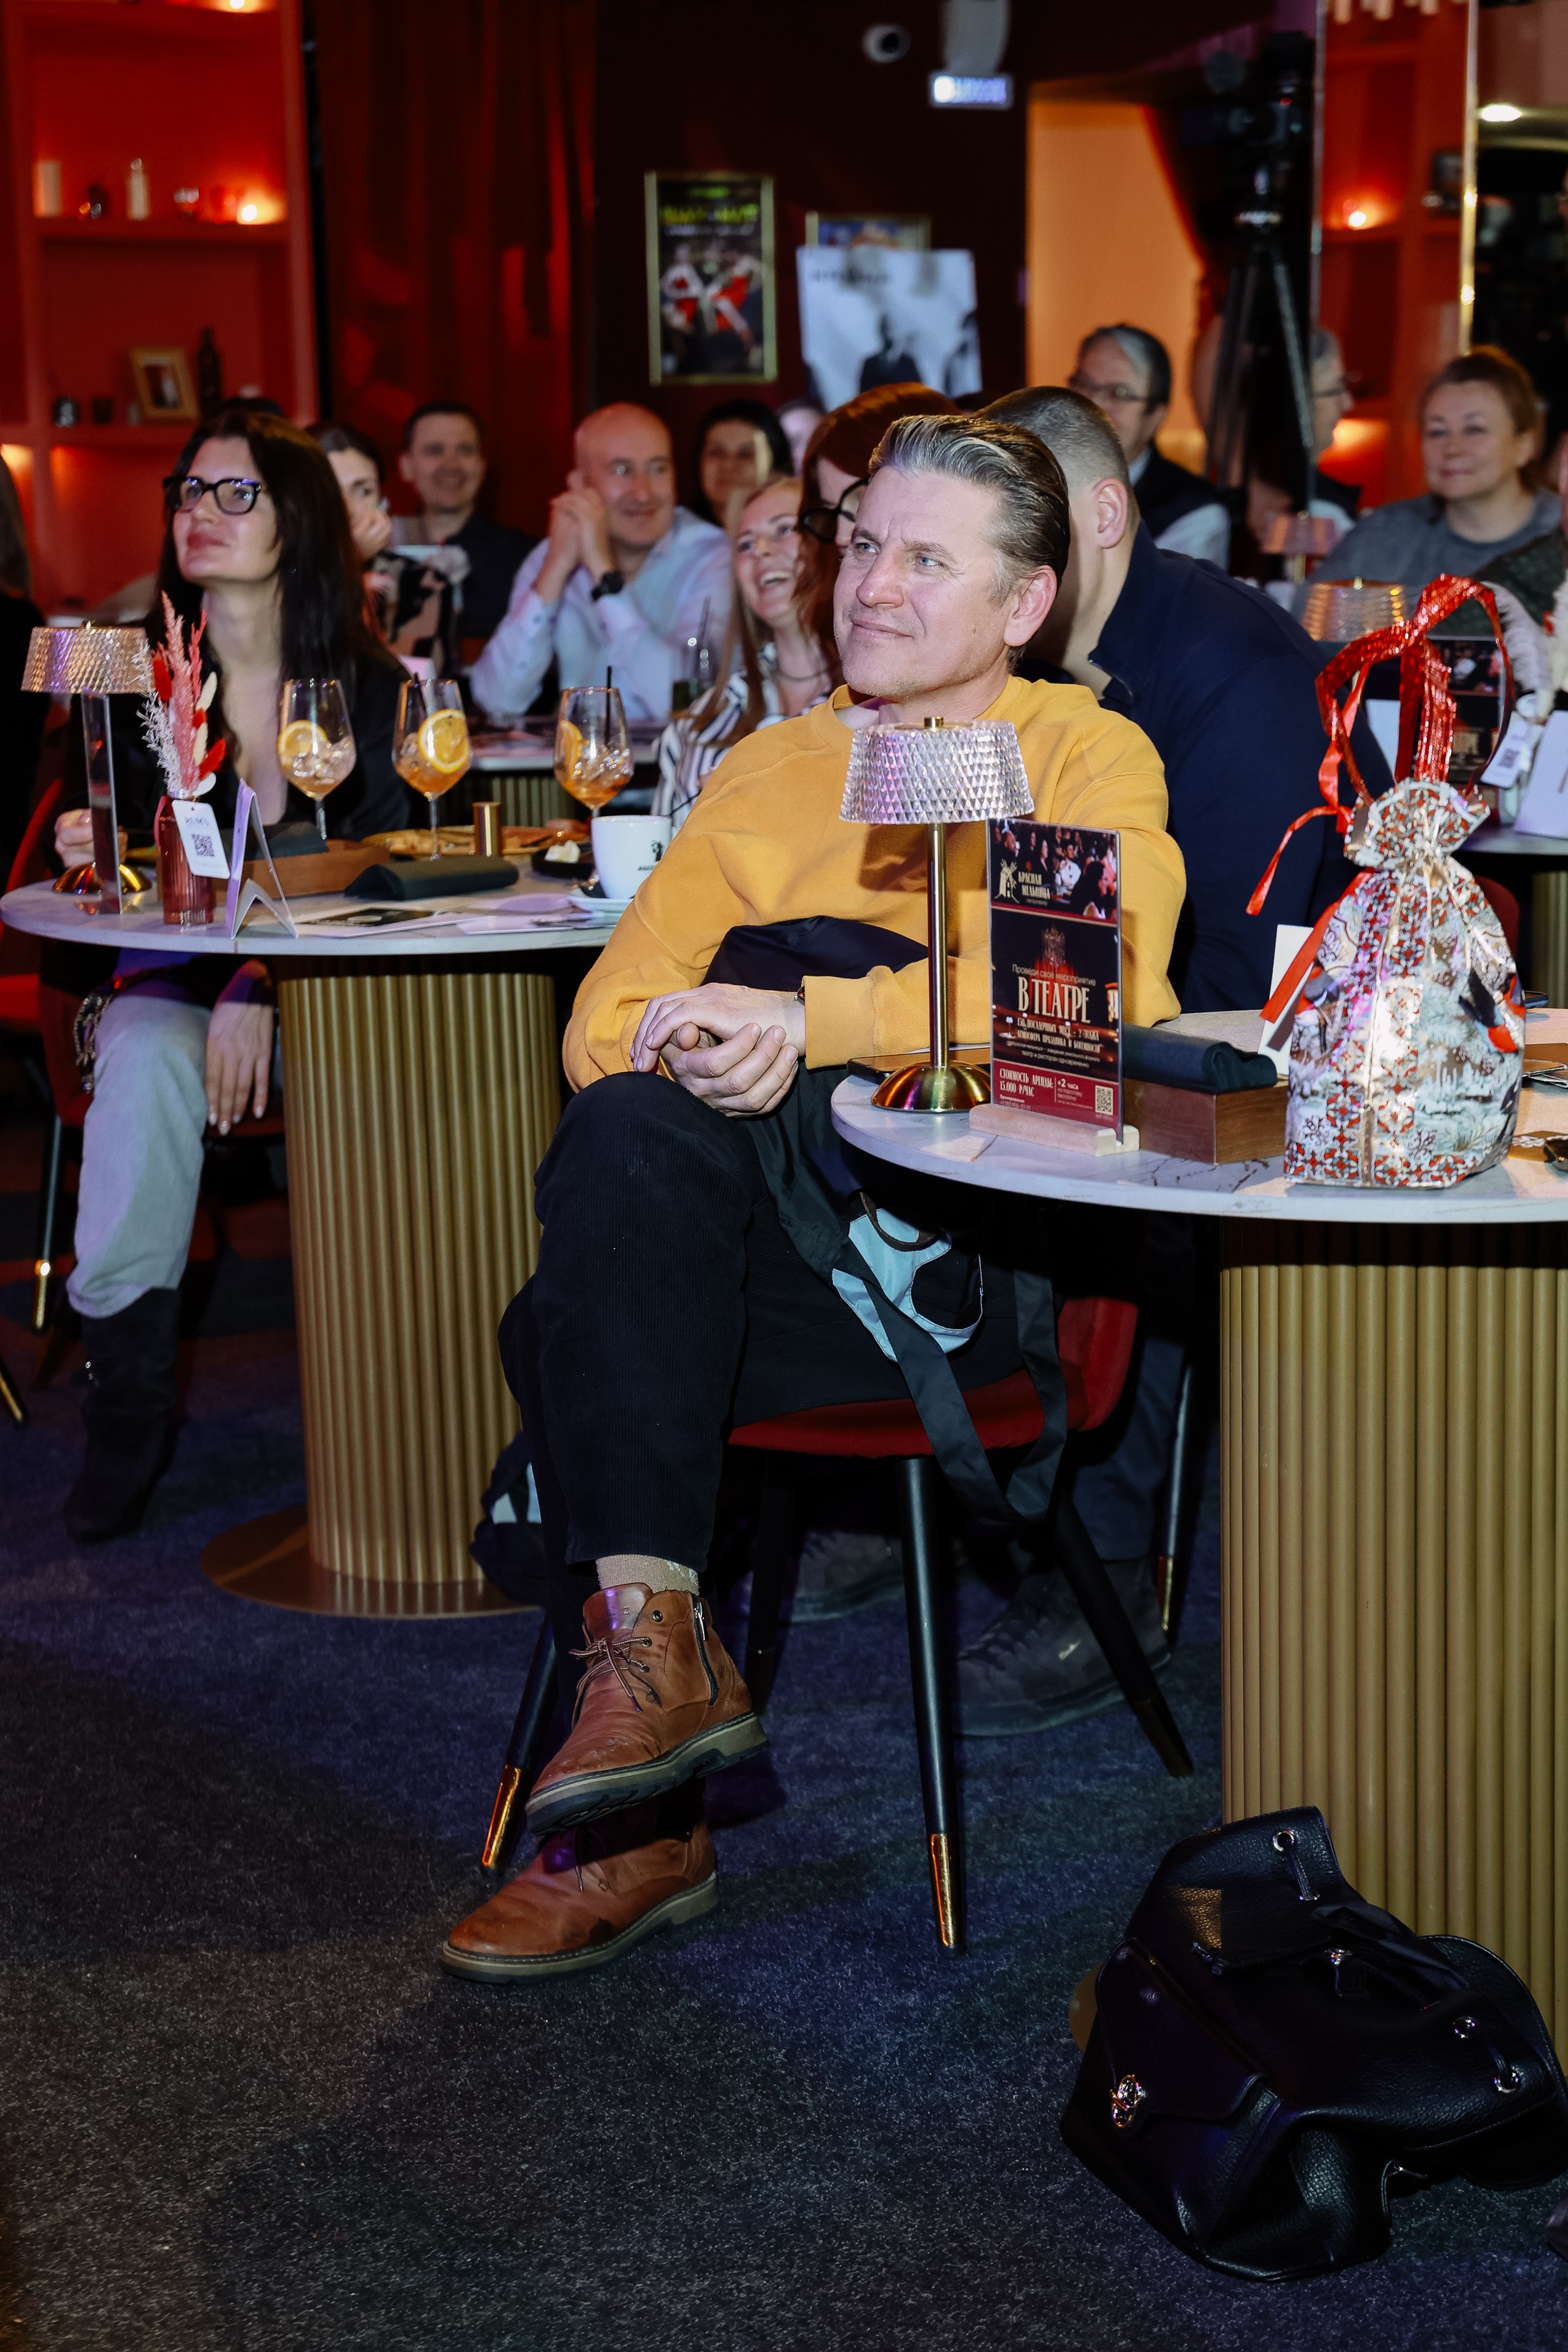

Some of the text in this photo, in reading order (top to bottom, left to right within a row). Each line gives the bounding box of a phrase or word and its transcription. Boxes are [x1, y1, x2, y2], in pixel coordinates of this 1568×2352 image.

[1012, 964, 1039, 976] Проведи
[1055, 972, 1096, 986] мероприятие
[1018, 976, 1091, 1024] В ТЕАТРЕ
[999, 1068, 1053, 1088] СТОИМОСТЬ АРЕНДЫ:
[1058, 1078, 1066, 1088] +2
[1000, 1081, 1035, 1097] 15.000 Р/ЧАС
